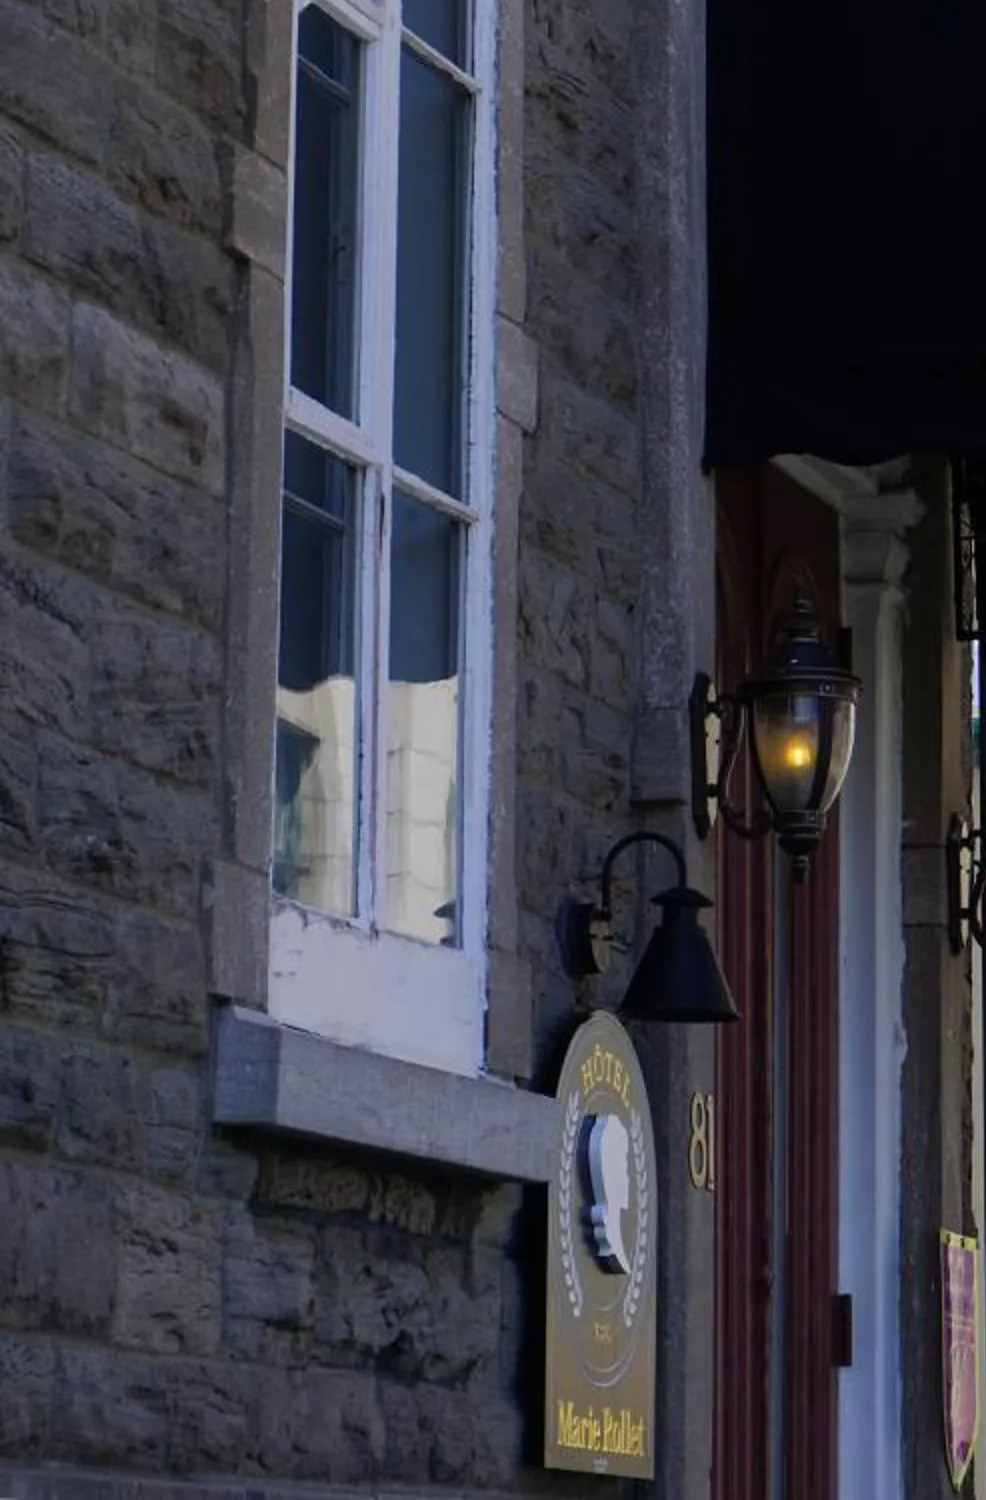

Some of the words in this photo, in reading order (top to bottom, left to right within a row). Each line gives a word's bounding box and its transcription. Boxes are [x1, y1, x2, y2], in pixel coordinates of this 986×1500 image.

[580, 1043, 631, 1108] HÔTEL
[689, 1092, 716, 1192] 81
[557, 1400, 601, 1451] Marie
[602, 1406, 646, 1457] Rollet
